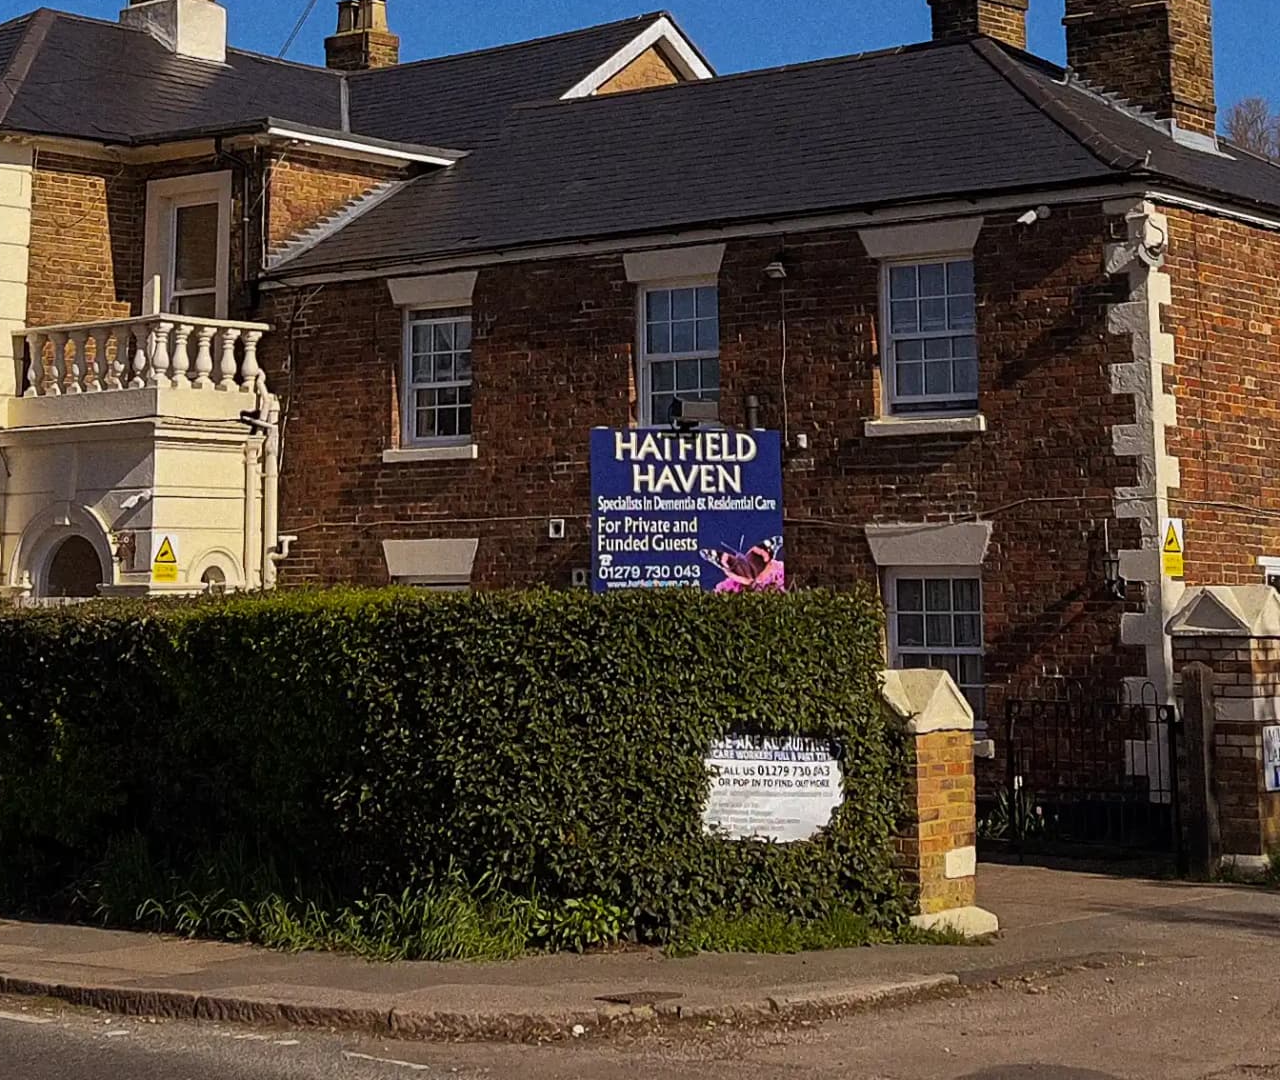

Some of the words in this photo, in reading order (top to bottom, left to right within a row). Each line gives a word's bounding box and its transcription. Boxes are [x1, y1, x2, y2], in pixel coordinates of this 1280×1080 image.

[614, 431, 757, 462] HATFIELD
[632, 463, 742, 493] HAVEN
[597, 495, 642, 513] Specialists
[653, 496, 696, 510] Dementia
[696, 496, 706, 510] &
[707, 496, 754, 510] Residential
[754, 495, 776, 510] Care
[597, 517, 622, 533] For
[624, 517, 670, 533] Private
[673, 517, 698, 533] and
[597, 535, 649, 552] Funded
[652, 534, 698, 551] Guests
[598, 566, 640, 579] 01279
[645, 565, 670, 578] 730
[673, 565, 700, 578] 043
[743, 766, 755, 775] US
[758, 765, 790, 777] 01279
[792, 766, 811, 777] 730
[718, 778, 730, 786] OR
[733, 778, 750, 787] POP
[752, 779, 761, 787] IN
[763, 779, 773, 787] TO
[775, 779, 793, 787] FIND
